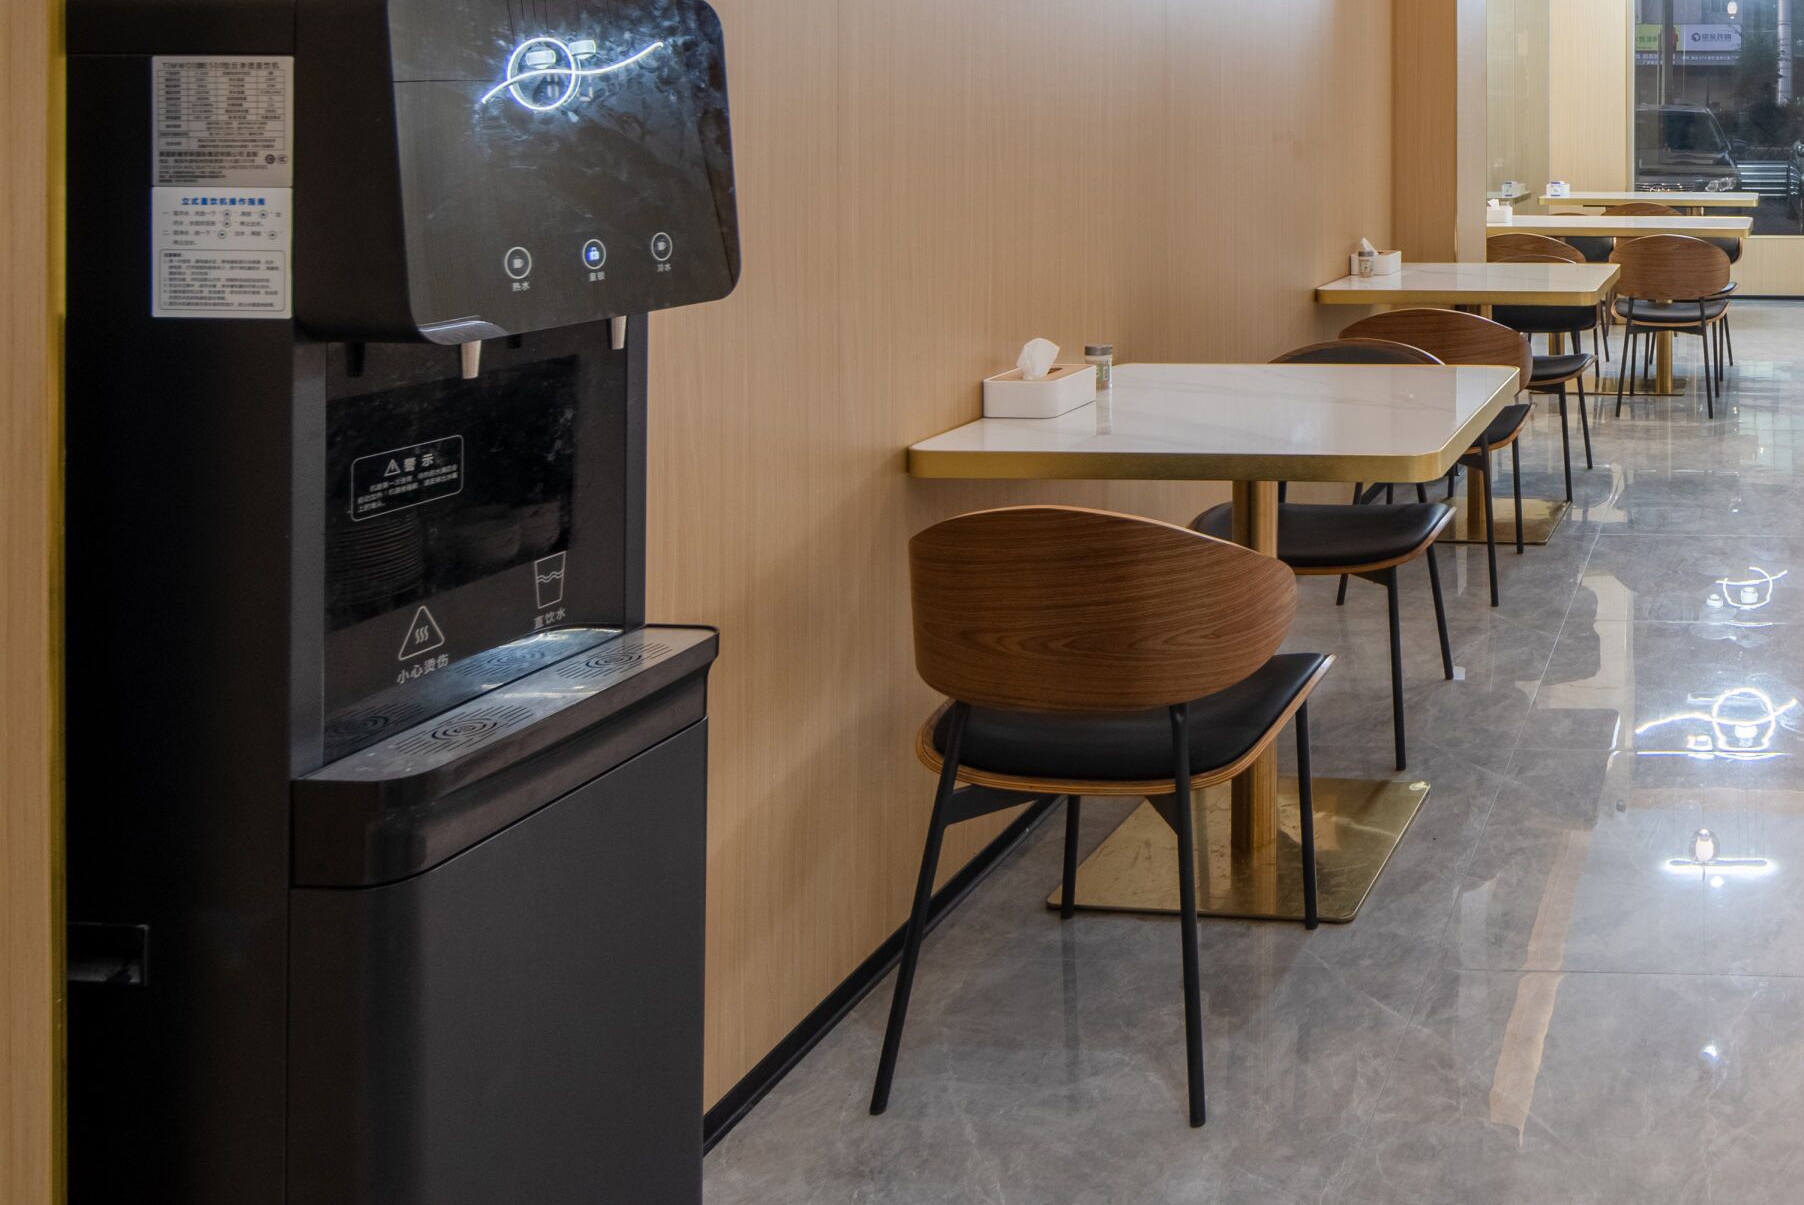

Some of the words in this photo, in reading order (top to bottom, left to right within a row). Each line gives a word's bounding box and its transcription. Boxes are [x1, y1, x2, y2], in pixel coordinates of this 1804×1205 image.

[511, 281, 531, 293] 热水
[403, 453, 434, 473] 警示
[533, 607, 567, 630] 直饮水
[396, 653, 449, 685] 小心烫伤
